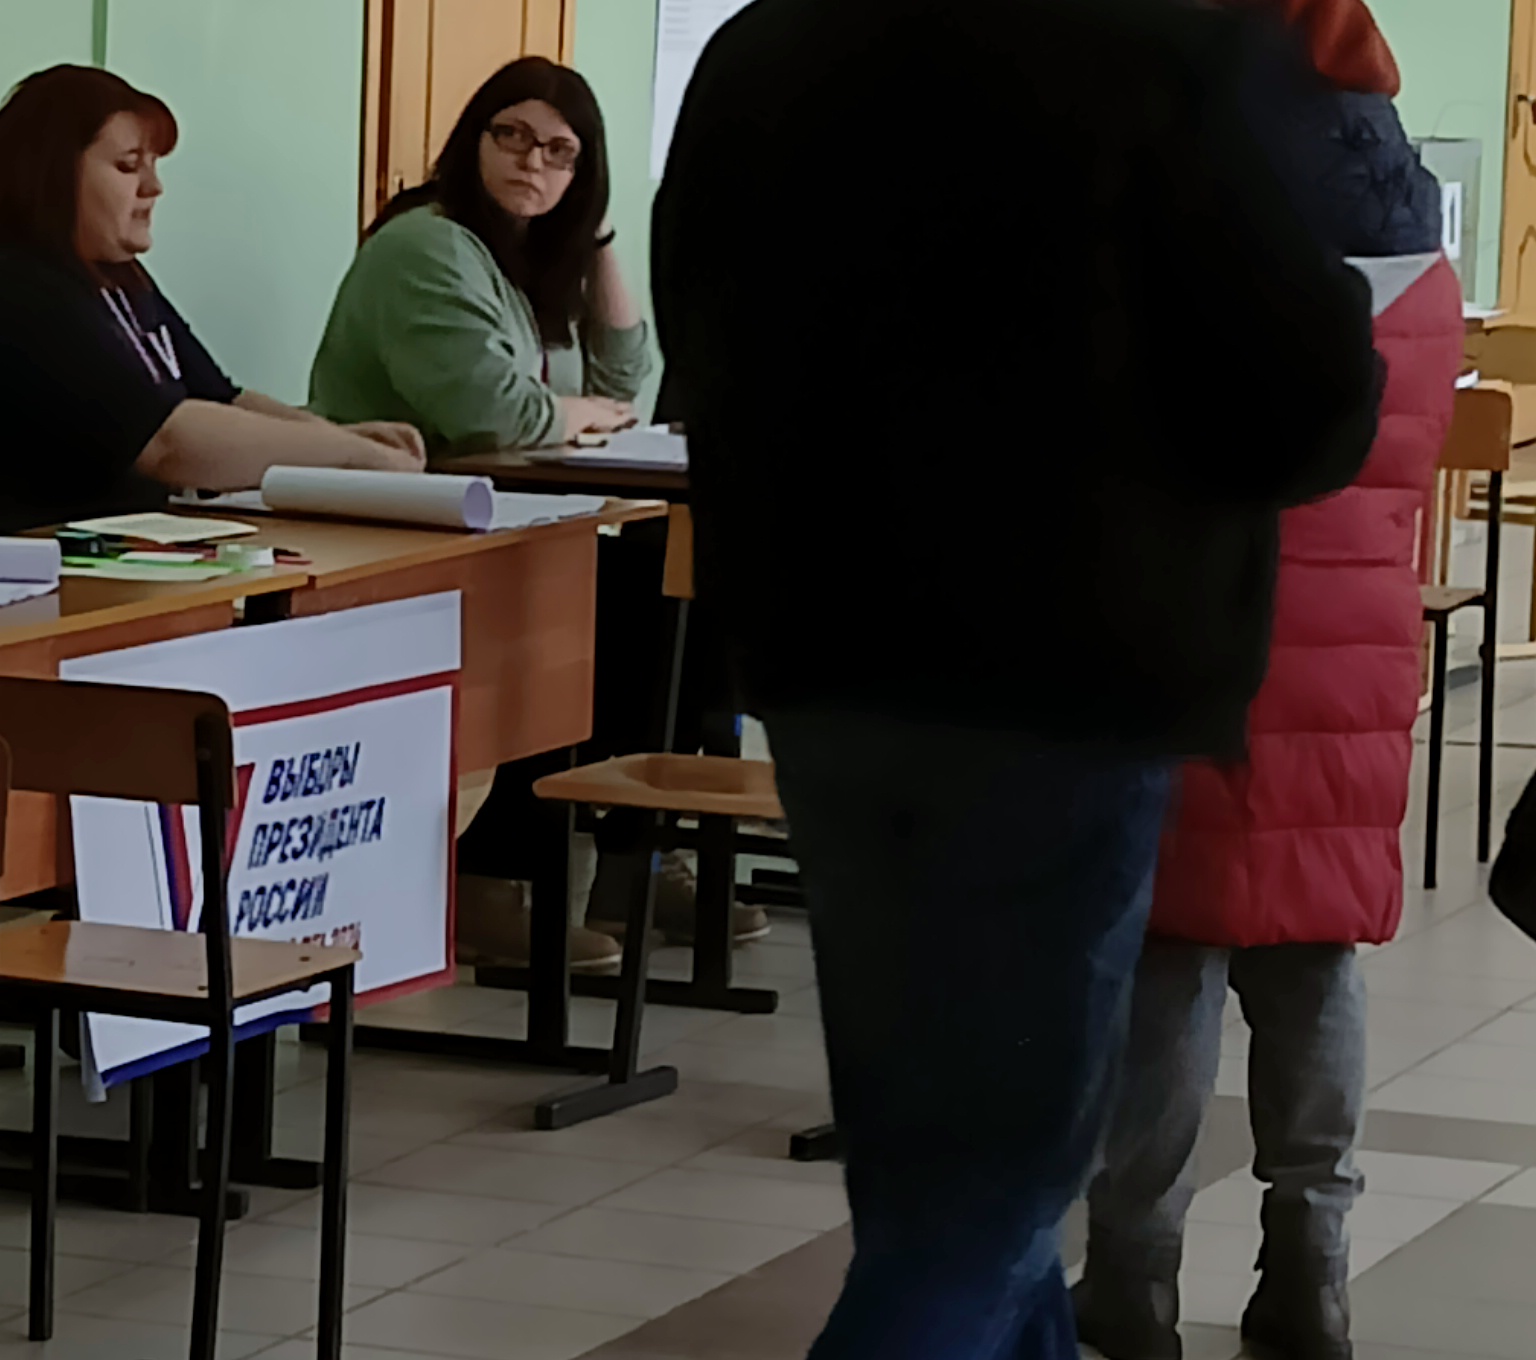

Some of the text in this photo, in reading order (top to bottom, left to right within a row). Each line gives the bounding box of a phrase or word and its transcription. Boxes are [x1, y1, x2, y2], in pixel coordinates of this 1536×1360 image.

[261, 740, 362, 805] ВЫБОРЫ
[247, 795, 387, 871] ПРЕЗИДЕНТА
[233, 871, 330, 935] РОССИИ
